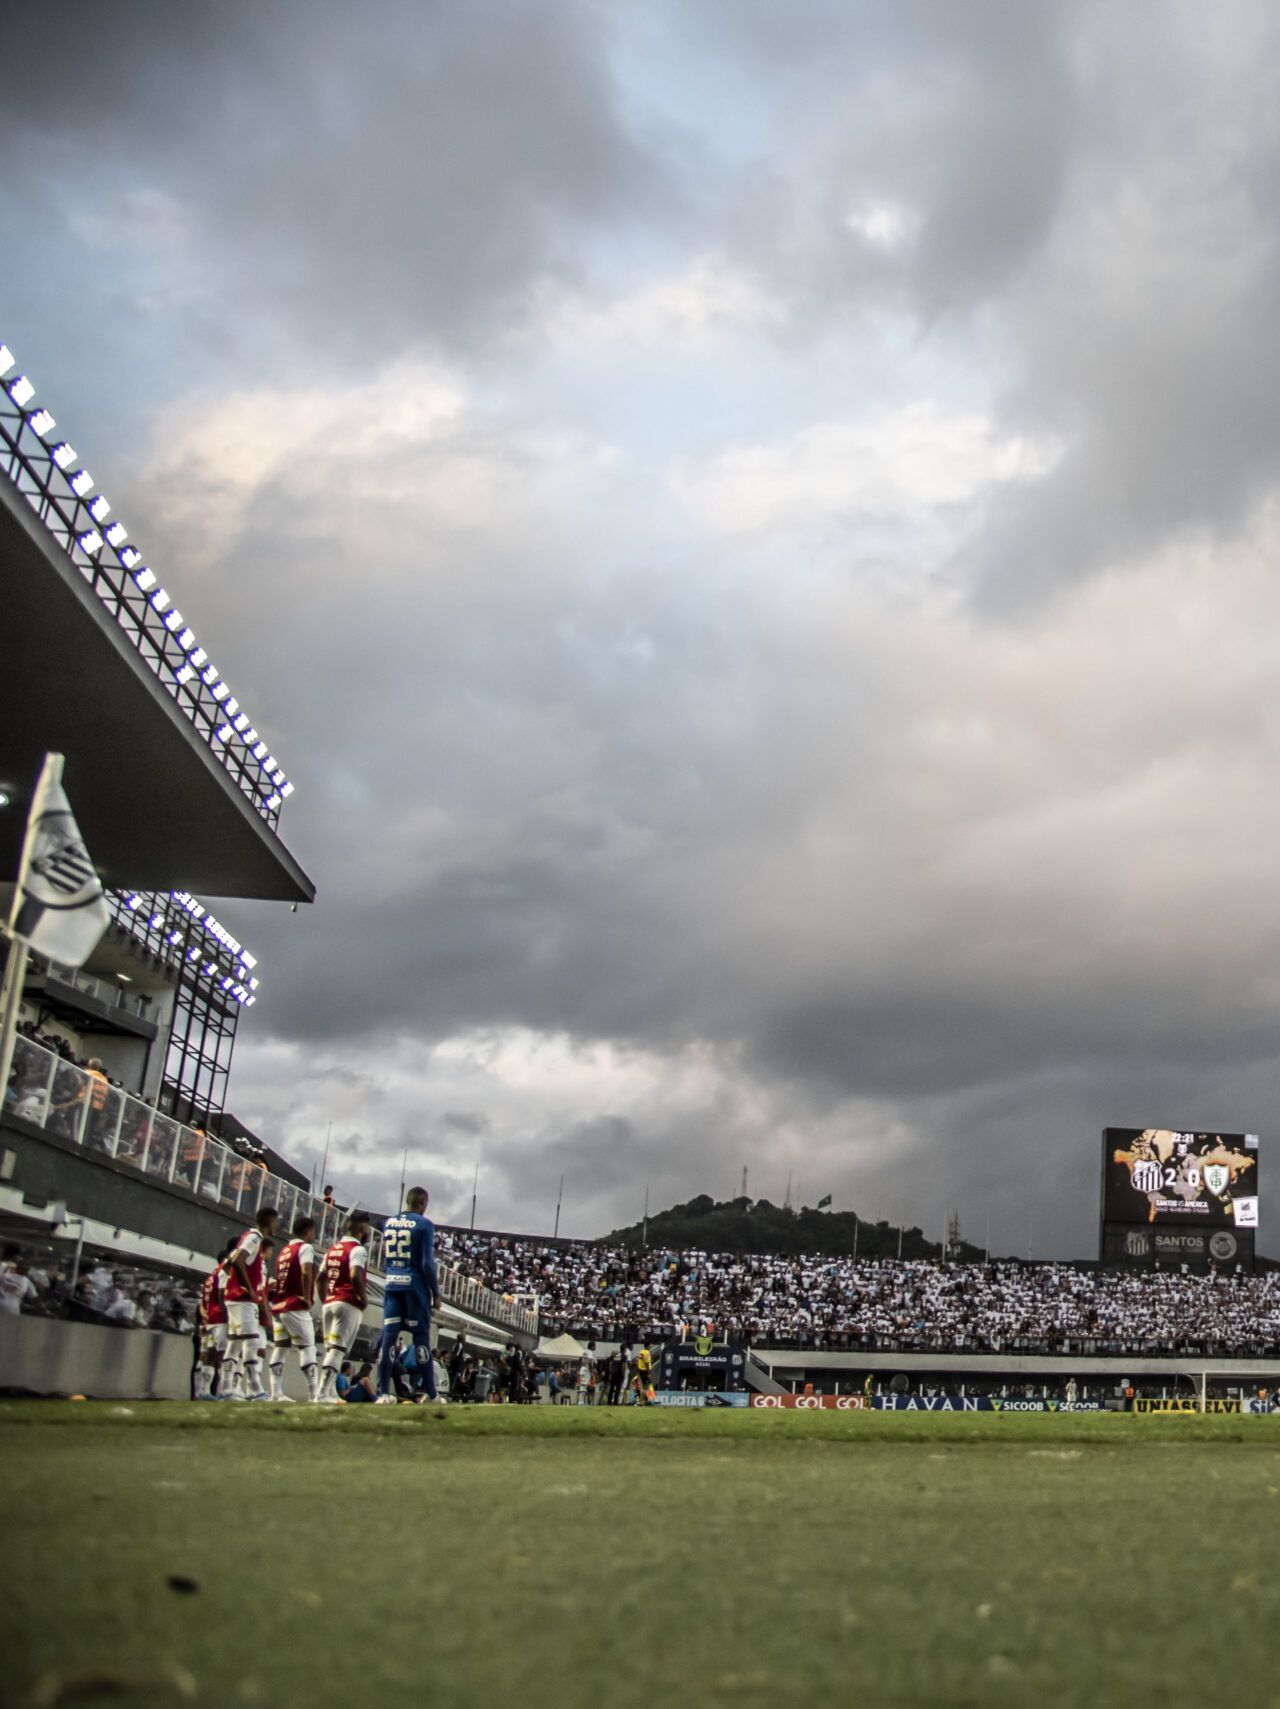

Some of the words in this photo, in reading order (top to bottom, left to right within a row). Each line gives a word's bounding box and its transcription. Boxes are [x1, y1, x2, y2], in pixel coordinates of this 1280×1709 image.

[1165, 1168, 1177, 1186] 2
[1188, 1169, 1200, 1187] 0
[385, 1216, 416, 1228] Philco
[384, 1229, 411, 1258] 22
[1155, 1235, 1204, 1247] SANTOS
[754, 1396, 785, 1408] GOL
[795, 1396, 826, 1409] GOL
[836, 1397, 867, 1409] GOL
[881, 1396, 979, 1411] HAVAN
[1003, 1401, 1044, 1411] SICOOB
